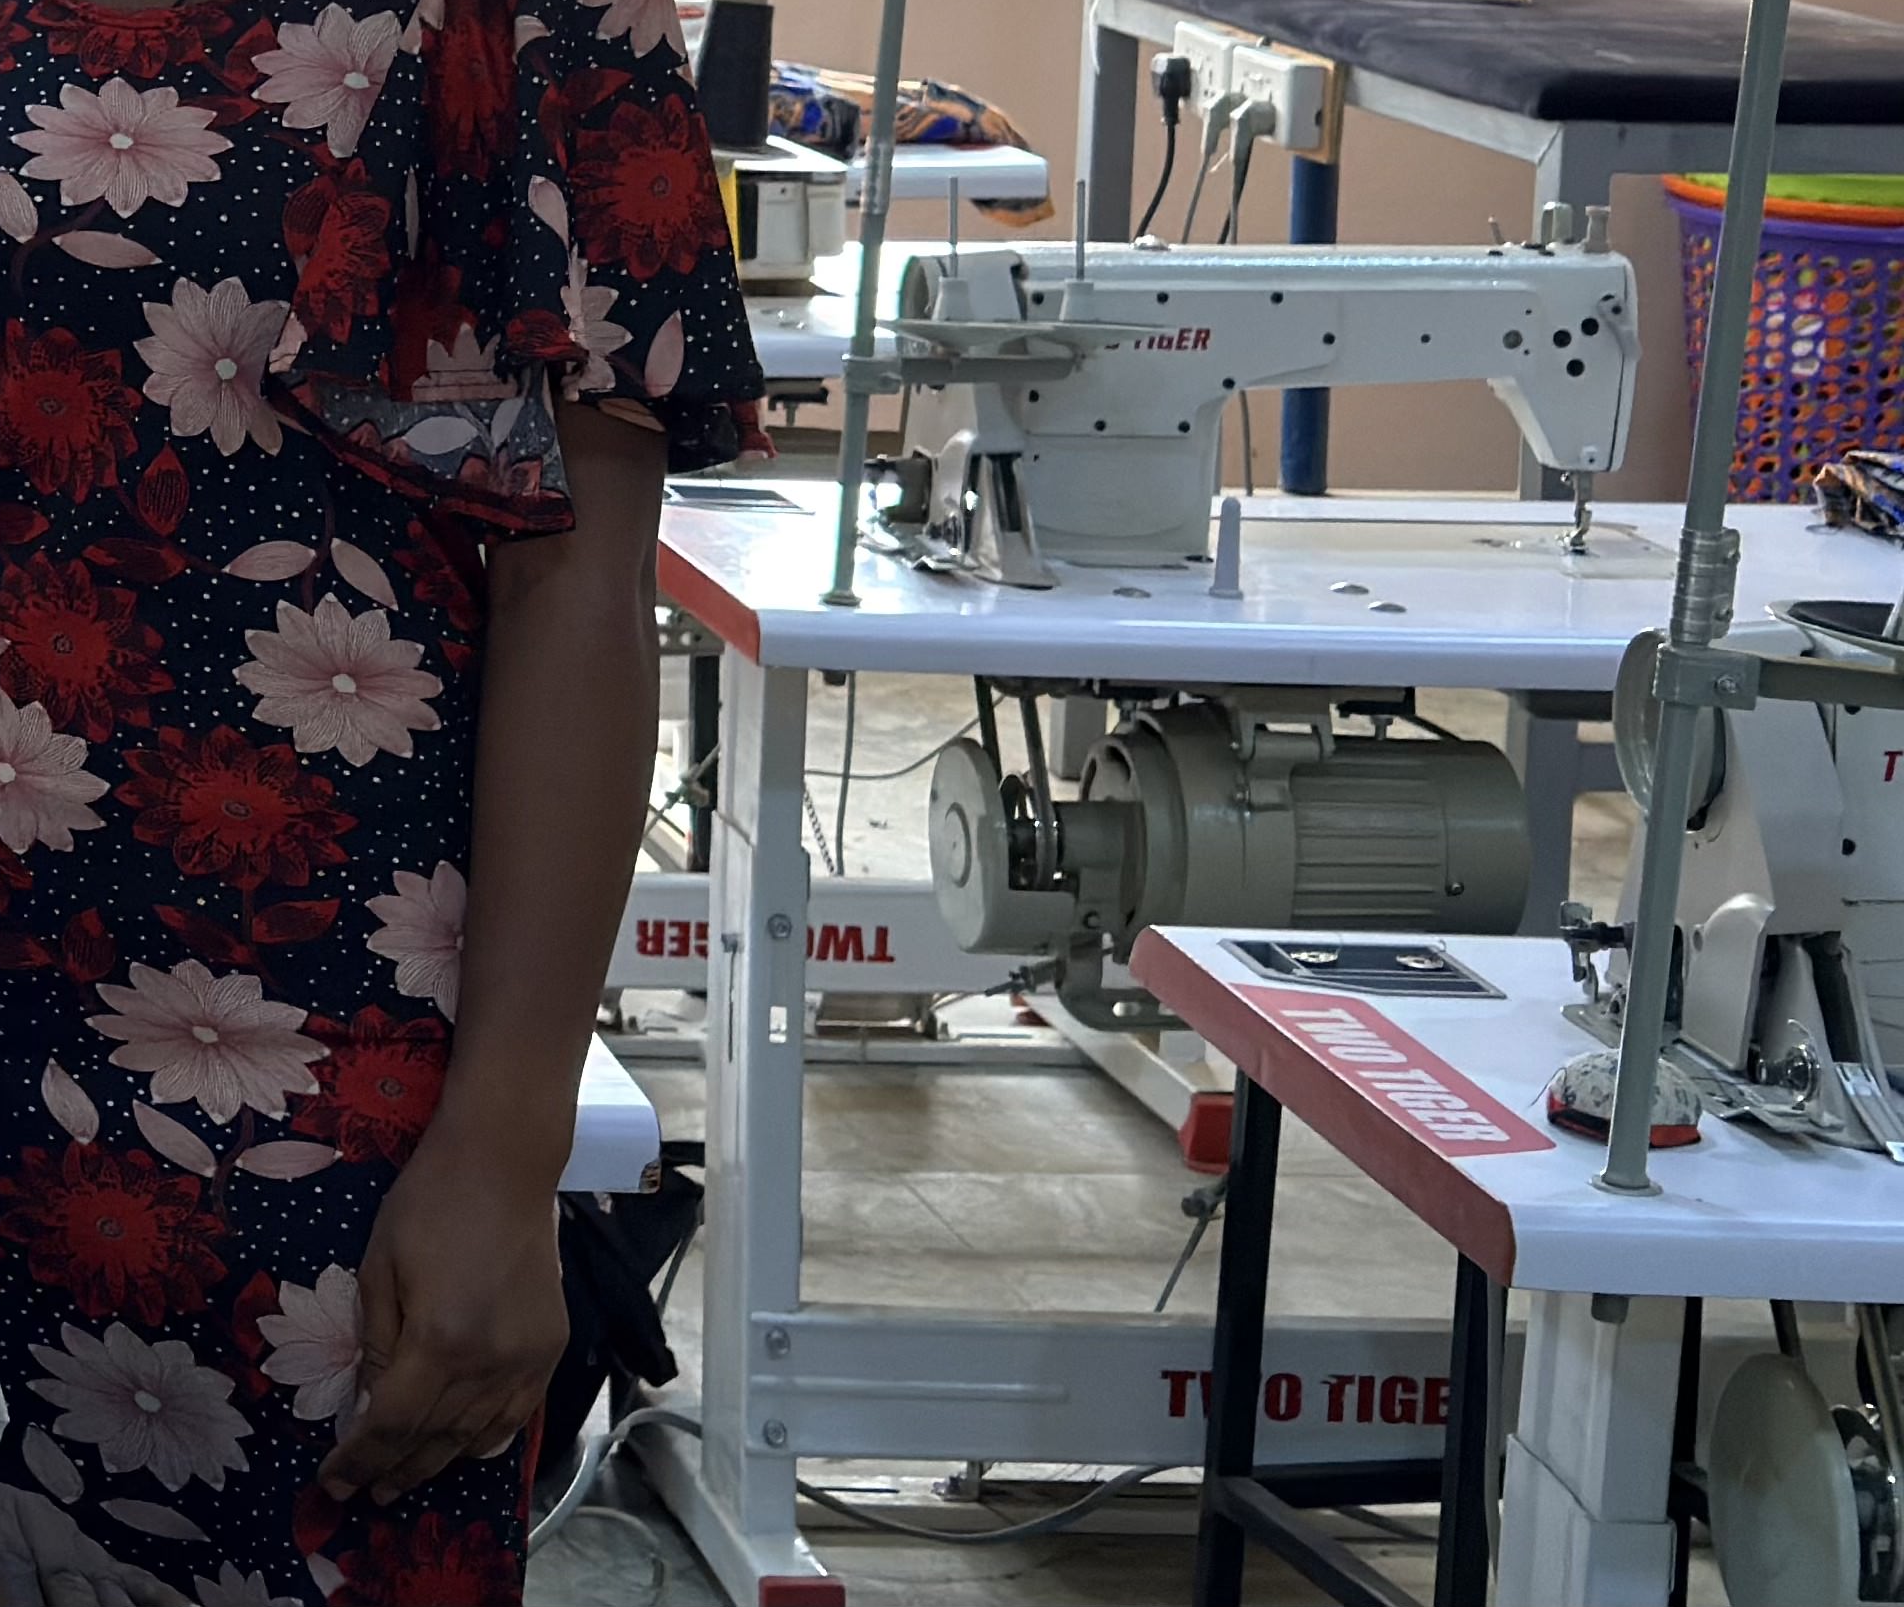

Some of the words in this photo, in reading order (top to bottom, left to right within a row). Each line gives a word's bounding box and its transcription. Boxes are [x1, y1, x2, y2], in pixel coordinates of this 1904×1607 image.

[636, 919, 708, 958] GER
[807, 924, 896, 962] TW
[1280, 1007, 1407, 1063] TWO
[1357, 1068, 1511, 1142] TIGER
[1161, 1370, 1302, 1422] TO
[1320, 1374, 1449, 1425] TIGE
